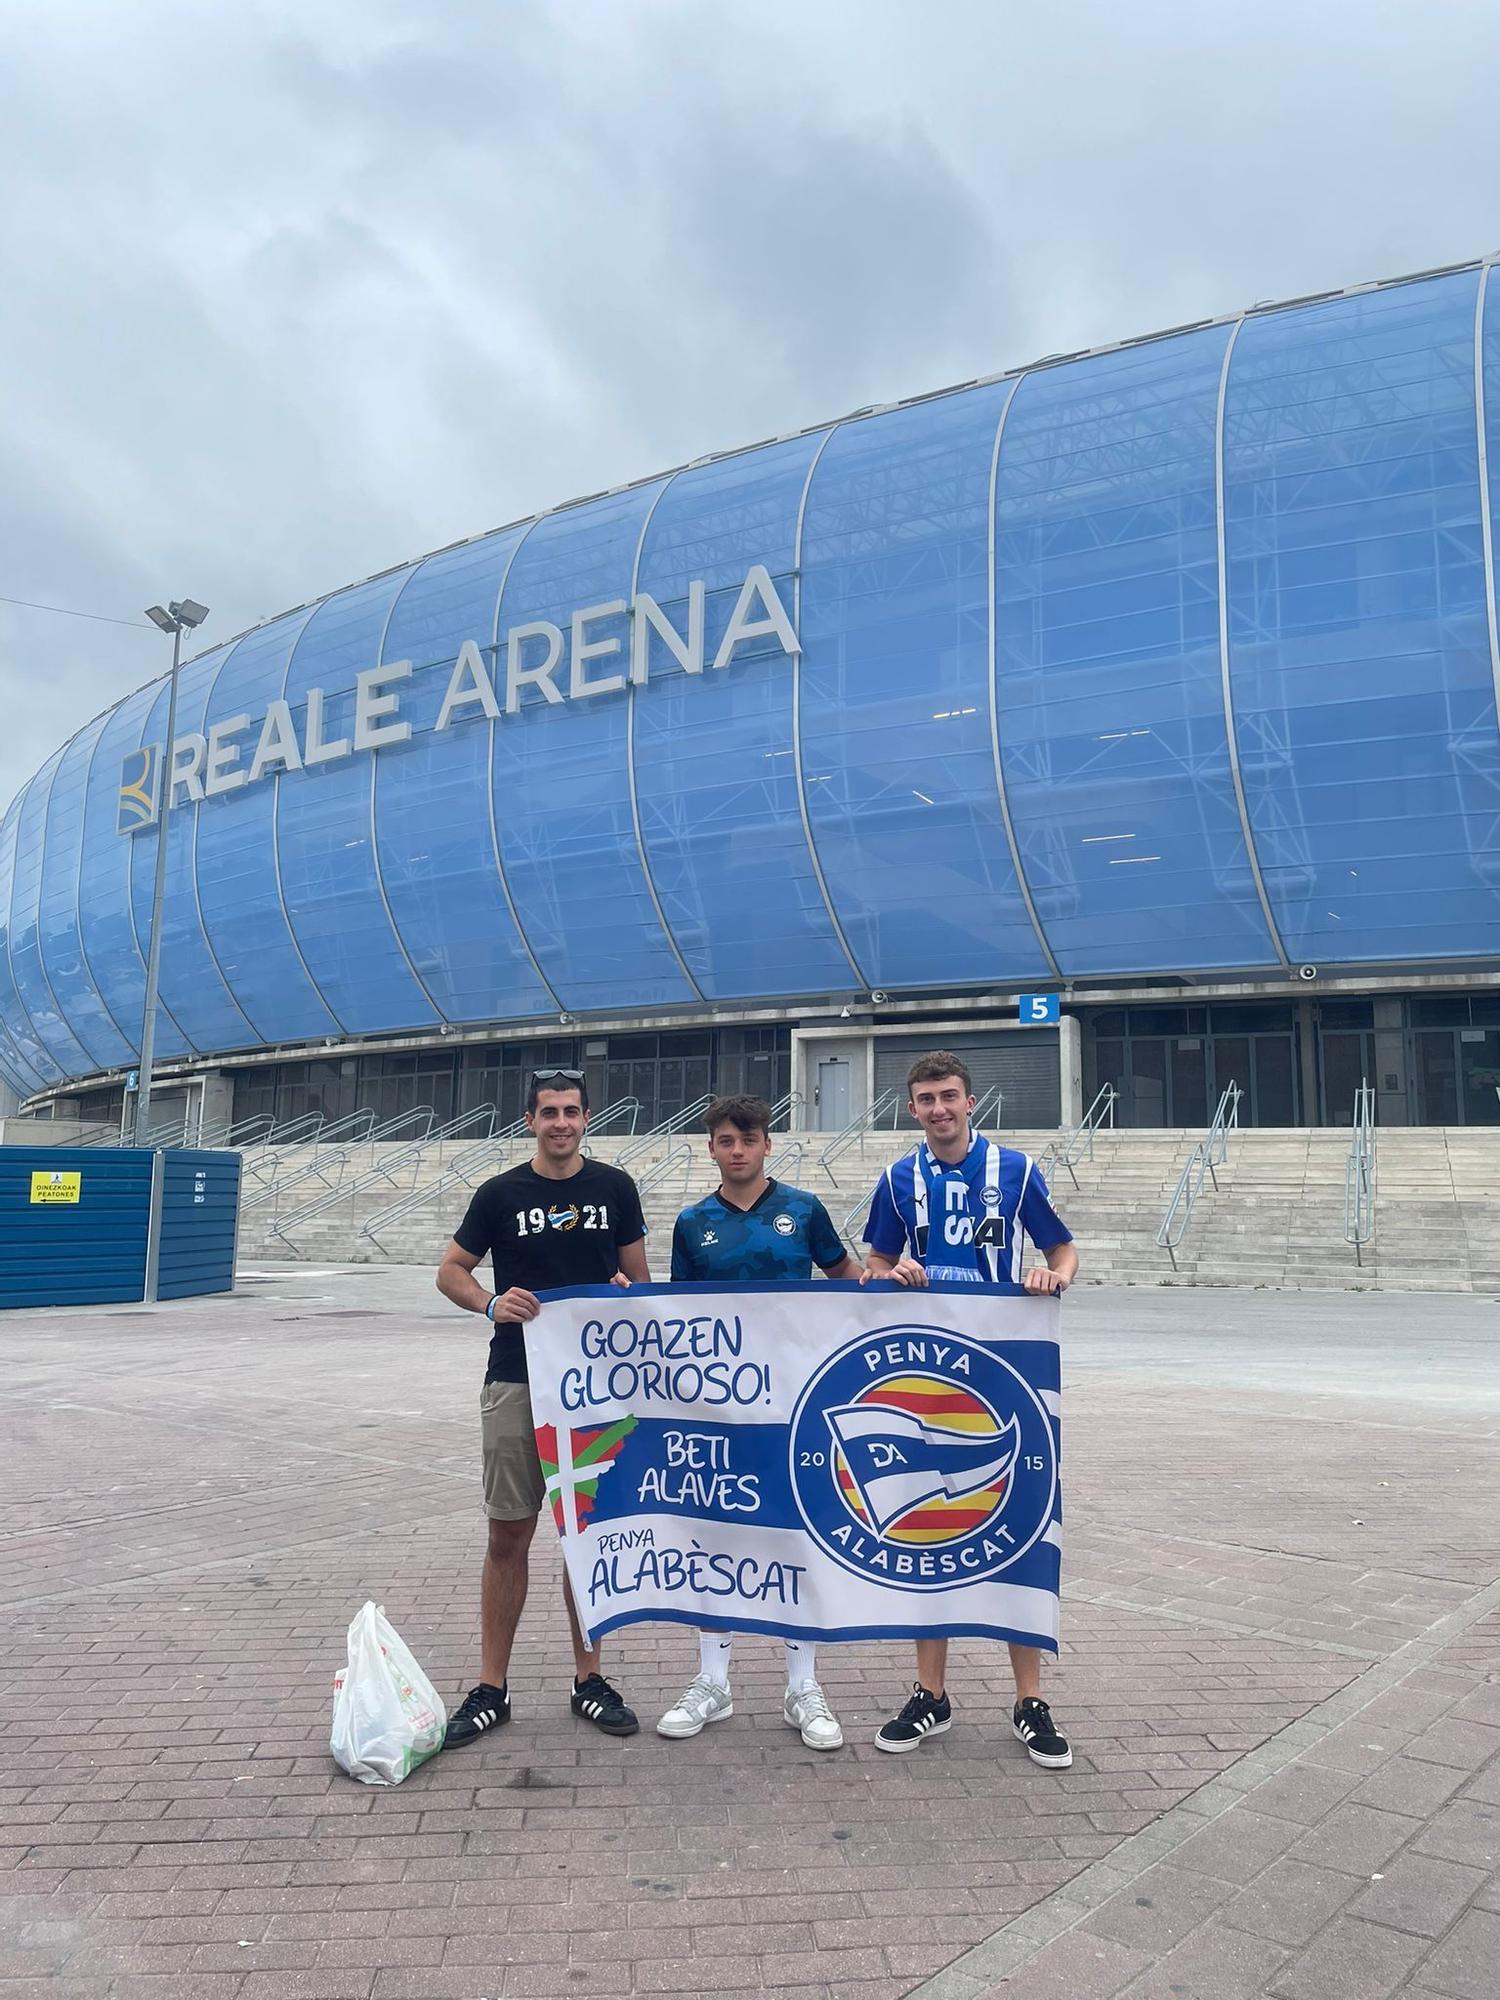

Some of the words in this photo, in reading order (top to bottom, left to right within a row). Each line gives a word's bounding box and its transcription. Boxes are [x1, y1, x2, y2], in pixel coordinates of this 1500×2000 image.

[169, 659, 412, 810] REALE
[435, 564, 801, 732] ARENA
[1031, 997, 1049, 1020] 5
[129, 1072, 135, 1087] 6
[515, 1206, 546, 1237] 19
[582, 1204, 609, 1231] 21
[580, 1315, 742, 1360] GOAZEN
[863, 1341, 971, 1376] PENYA
[560, 1360, 771, 1411] GLORIOSO!
[662, 1430, 730, 1469] BETI
[800, 1451, 825, 1467] 20
[1024, 1456, 1044, 1471] 15
[637, 1467, 761, 1512] ALAVES
[597, 1528, 655, 1555] PENYA
[830, 1523, 1017, 1576] ALABÈSCAT
[588, 1538, 807, 1607] ALABÈSCAT
